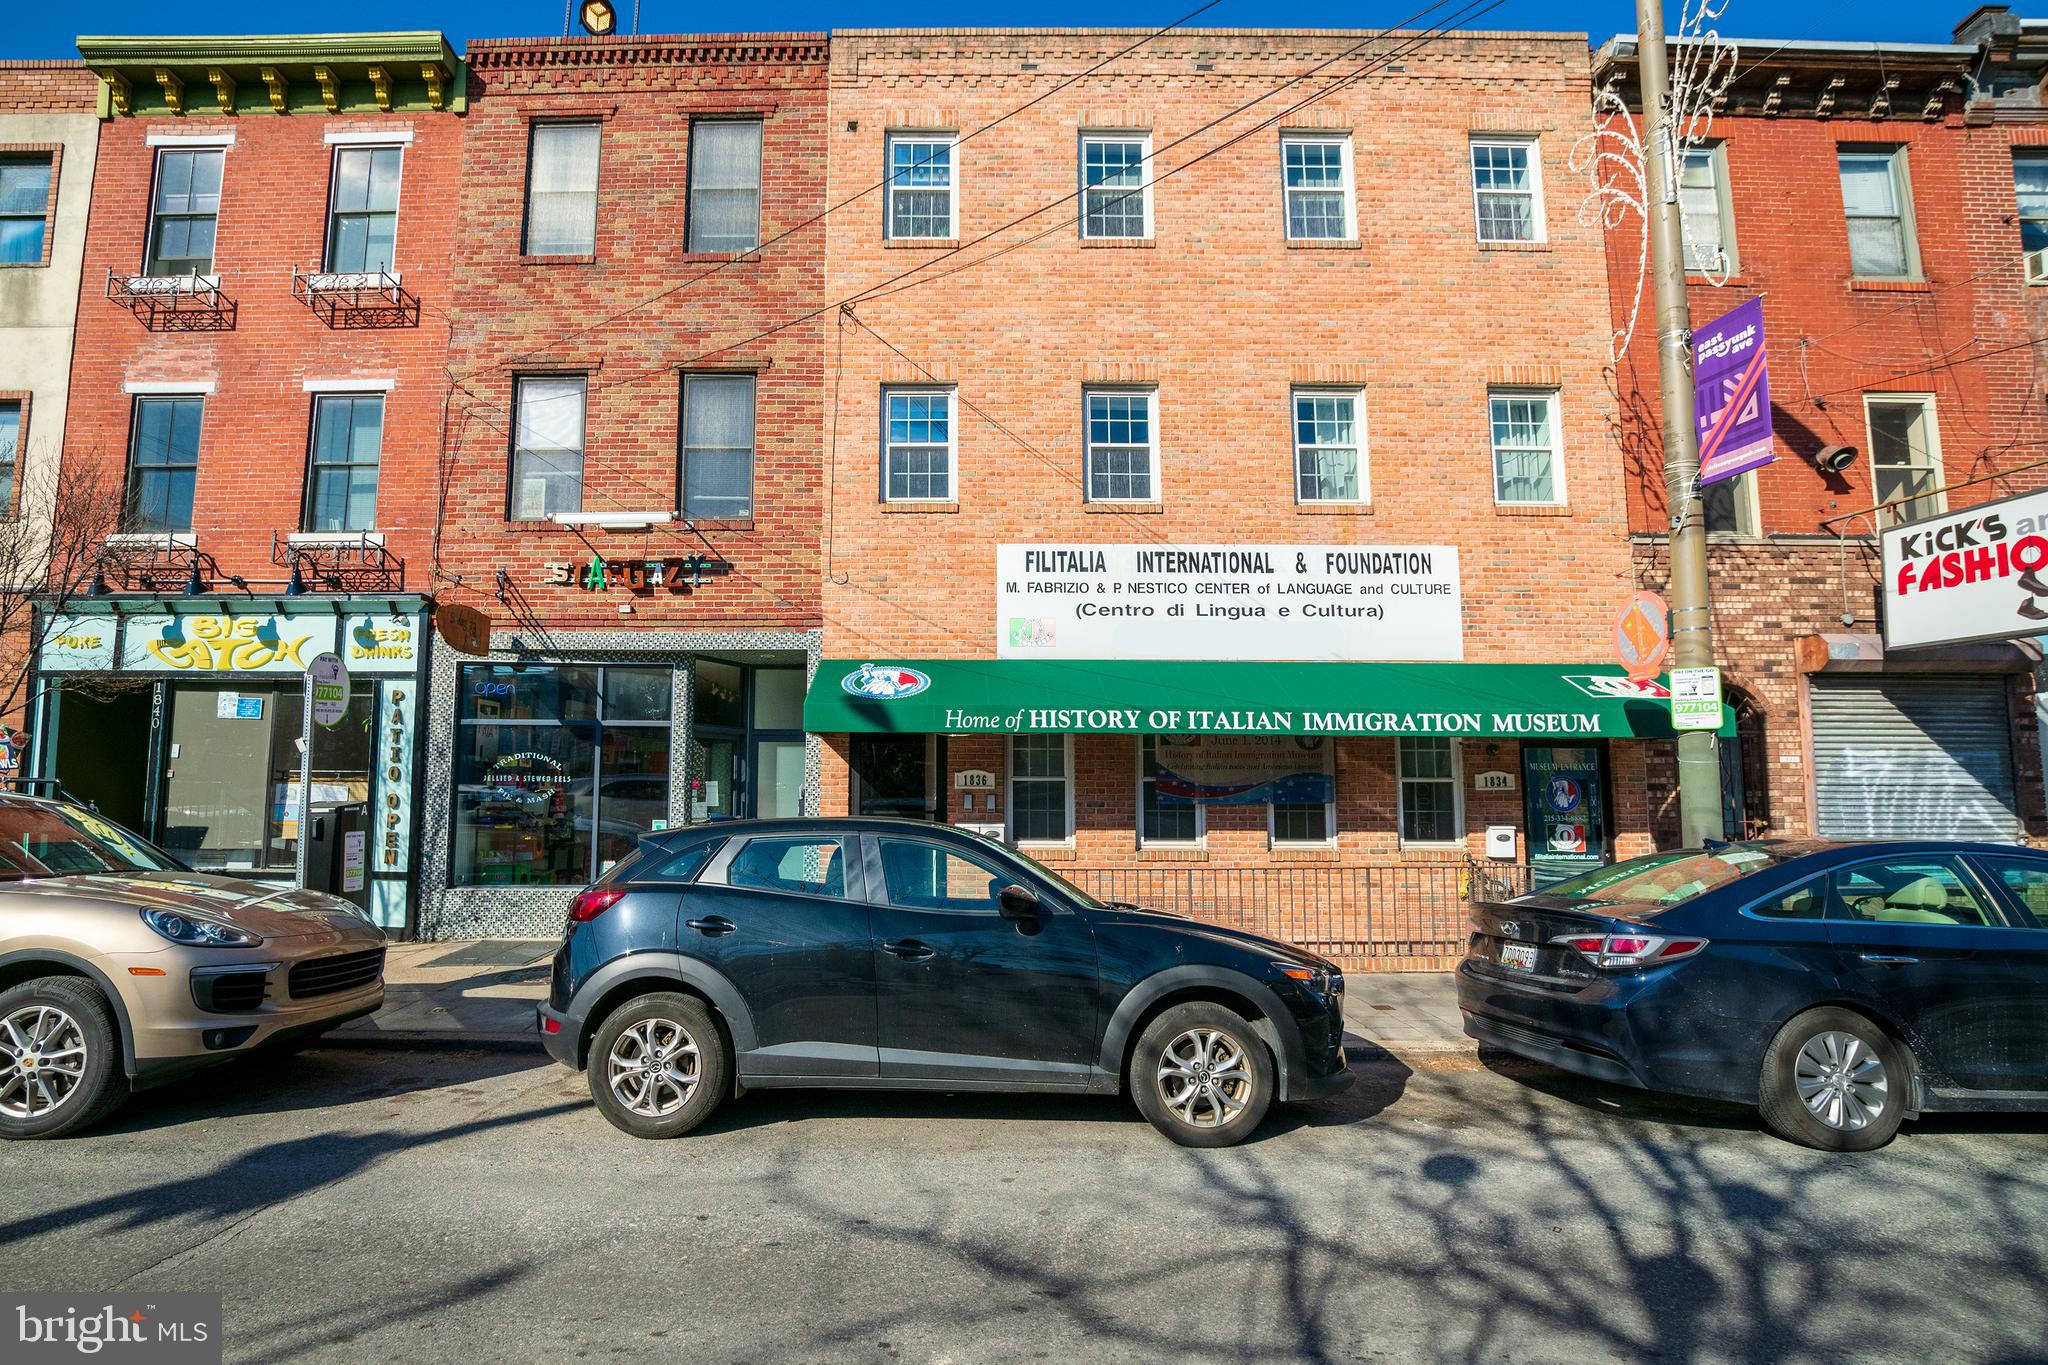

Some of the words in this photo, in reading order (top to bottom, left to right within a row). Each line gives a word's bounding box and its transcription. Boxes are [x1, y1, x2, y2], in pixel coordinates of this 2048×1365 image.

[1698, 332, 1723, 352] east
[1698, 324, 1756, 365] passyunk
[1732, 337, 1754, 355] ave
[551, 553, 705, 590] STARGAZY
[1025, 551, 1107, 573] FILITALIA
[1136, 551, 1275, 574] INTERNATIONAL
[1295, 552, 1308, 574] &
[1326, 552, 1432, 575] FOUNDATION
[1898, 535, 2048, 596] FASHIO
[1006, 582, 1020, 593] M.
[1027, 582, 1090, 594] FABRIZIO
[1096, 582, 1106, 594] &
[1113, 583, 1122, 594] P.
[1128, 582, 1188, 594] NESTICO
[1195, 583, 1250, 594] CENTER
[1257, 583, 1270, 594] of
[1277, 583, 1353, 595] LANGUAGE
[1360, 584, 1384, 595] and
[1391, 583, 1452, 595] CULTURE
[1075, 603, 1155, 620] (Centro
[1167, 604, 1184, 617] di
[1196, 604, 1266, 620] Lingua
[1278, 607, 1290, 617] e
[1302, 604, 1384, 620] Cultura)
[192, 616, 259, 638] BIG
[355, 627, 412, 643] FRESH
[147, 635, 314, 670] CATCH
[351, 645, 414, 660] DRINKS
[474, 681, 516, 697] open
[152, 682, 163, 729] 1840
[1675, 702, 1718, 713] 977104
[944, 709, 1000, 728] Home
[1005, 709, 1024, 732] of
[1029, 710, 1141, 729] HISTORY
[1148, 710, 1182, 729] OF
[1187, 711, 1292, 730] ITALIAN
[1303, 712, 1482, 732] IMMIGRATION
[1492, 713, 1601, 732] MUSEUM
[388, 689, 406, 783] PATIO
[1211, 735, 1238, 746] June
[1255, 736, 1282, 746] 2014
[493, 752, 563, 771] TRADITIONAL
[1165, 750, 1194, 761] History
[1197, 750, 1205, 760] of
[1205, 751, 1232, 760] Italian
[1234, 751, 1287, 761] Immigration
[1288, 751, 1322, 760] Museum
[1529, 763, 1558, 771] MUSEUM
[1560, 763, 1596, 771] ENTRANCE
[483, 774, 513, 782] JELLIED
[554, 775, 572, 783] EELS
[964, 774, 987, 786] 1836
[1484, 776, 1508, 787] 1834
[497, 787, 513, 801] PIE
[526, 788, 556, 804] MASH
[361, 804, 368, 816] A
[384, 792, 401, 867] OPEN
